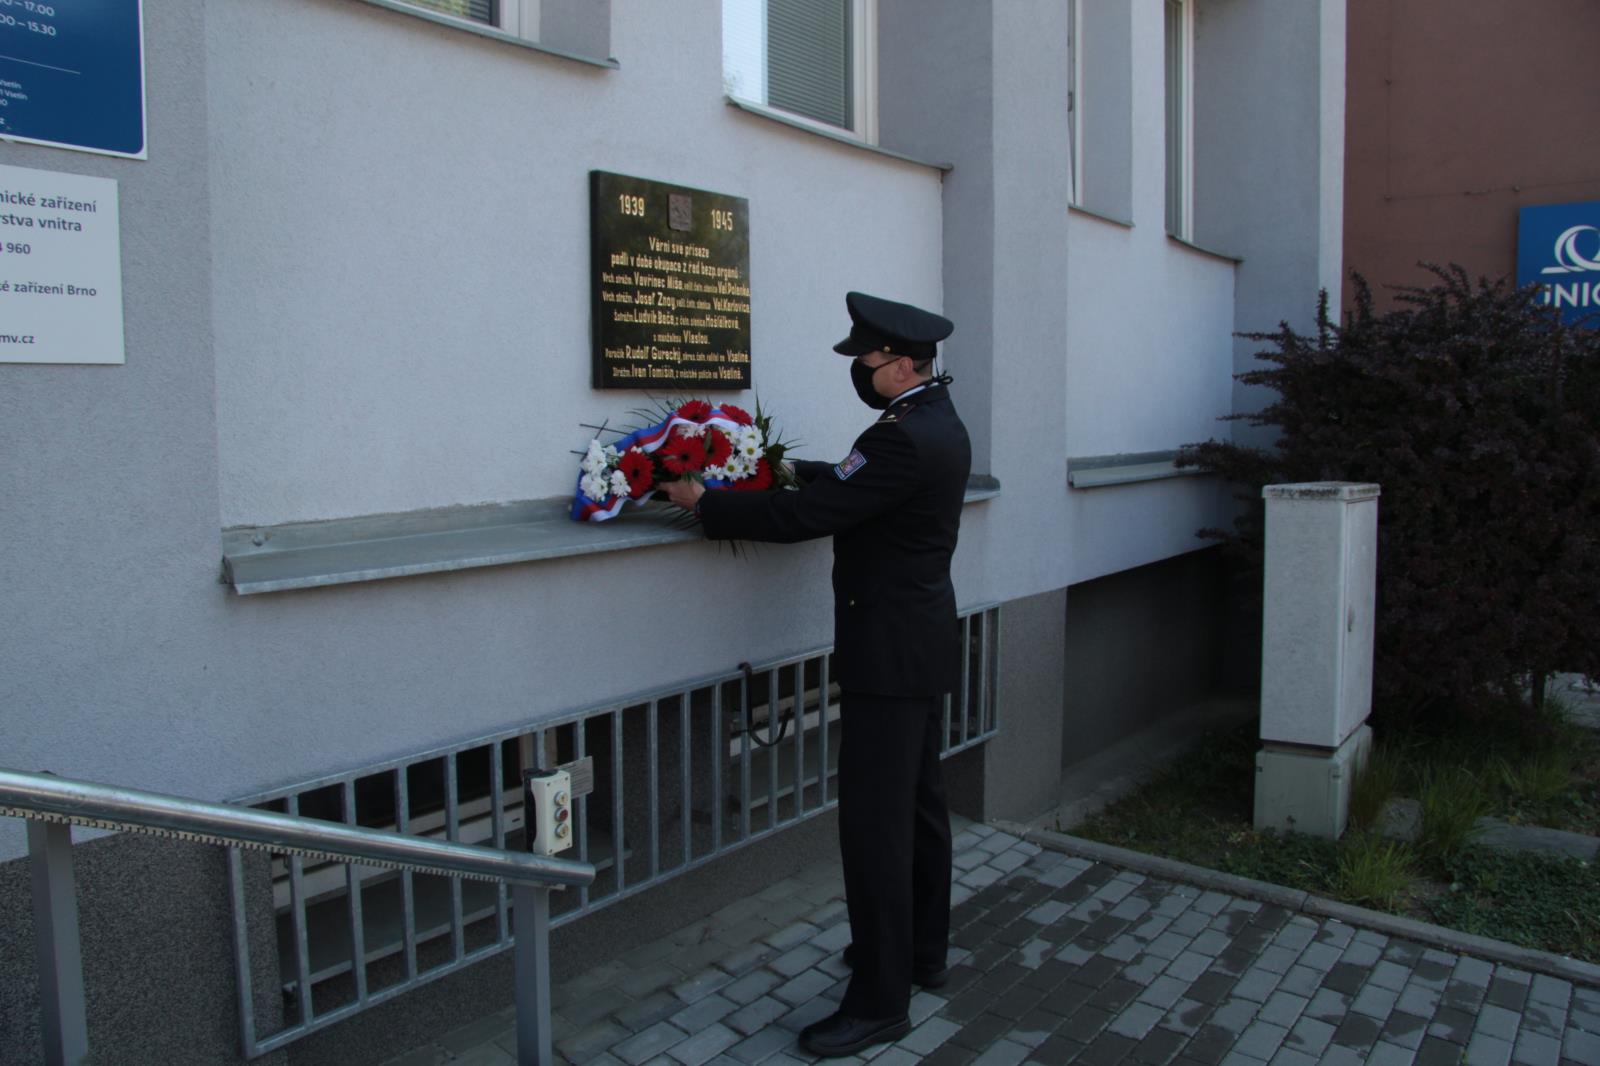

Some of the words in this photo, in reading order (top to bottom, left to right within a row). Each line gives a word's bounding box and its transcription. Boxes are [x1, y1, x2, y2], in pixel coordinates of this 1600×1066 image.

[24, 1, 55, 17] 17.00
[27, 21, 56, 36] 15.30
[40, 196, 97, 213] zařízení
[619, 194, 646, 217] 1939
[710, 209, 734, 231] 1945
[0, 213, 34, 228] stva
[38, 217, 82, 232] vnitra
[6, 242, 31, 255] 960
[13, 282, 64, 295] zařízení
[67, 285, 97, 296] Brno
